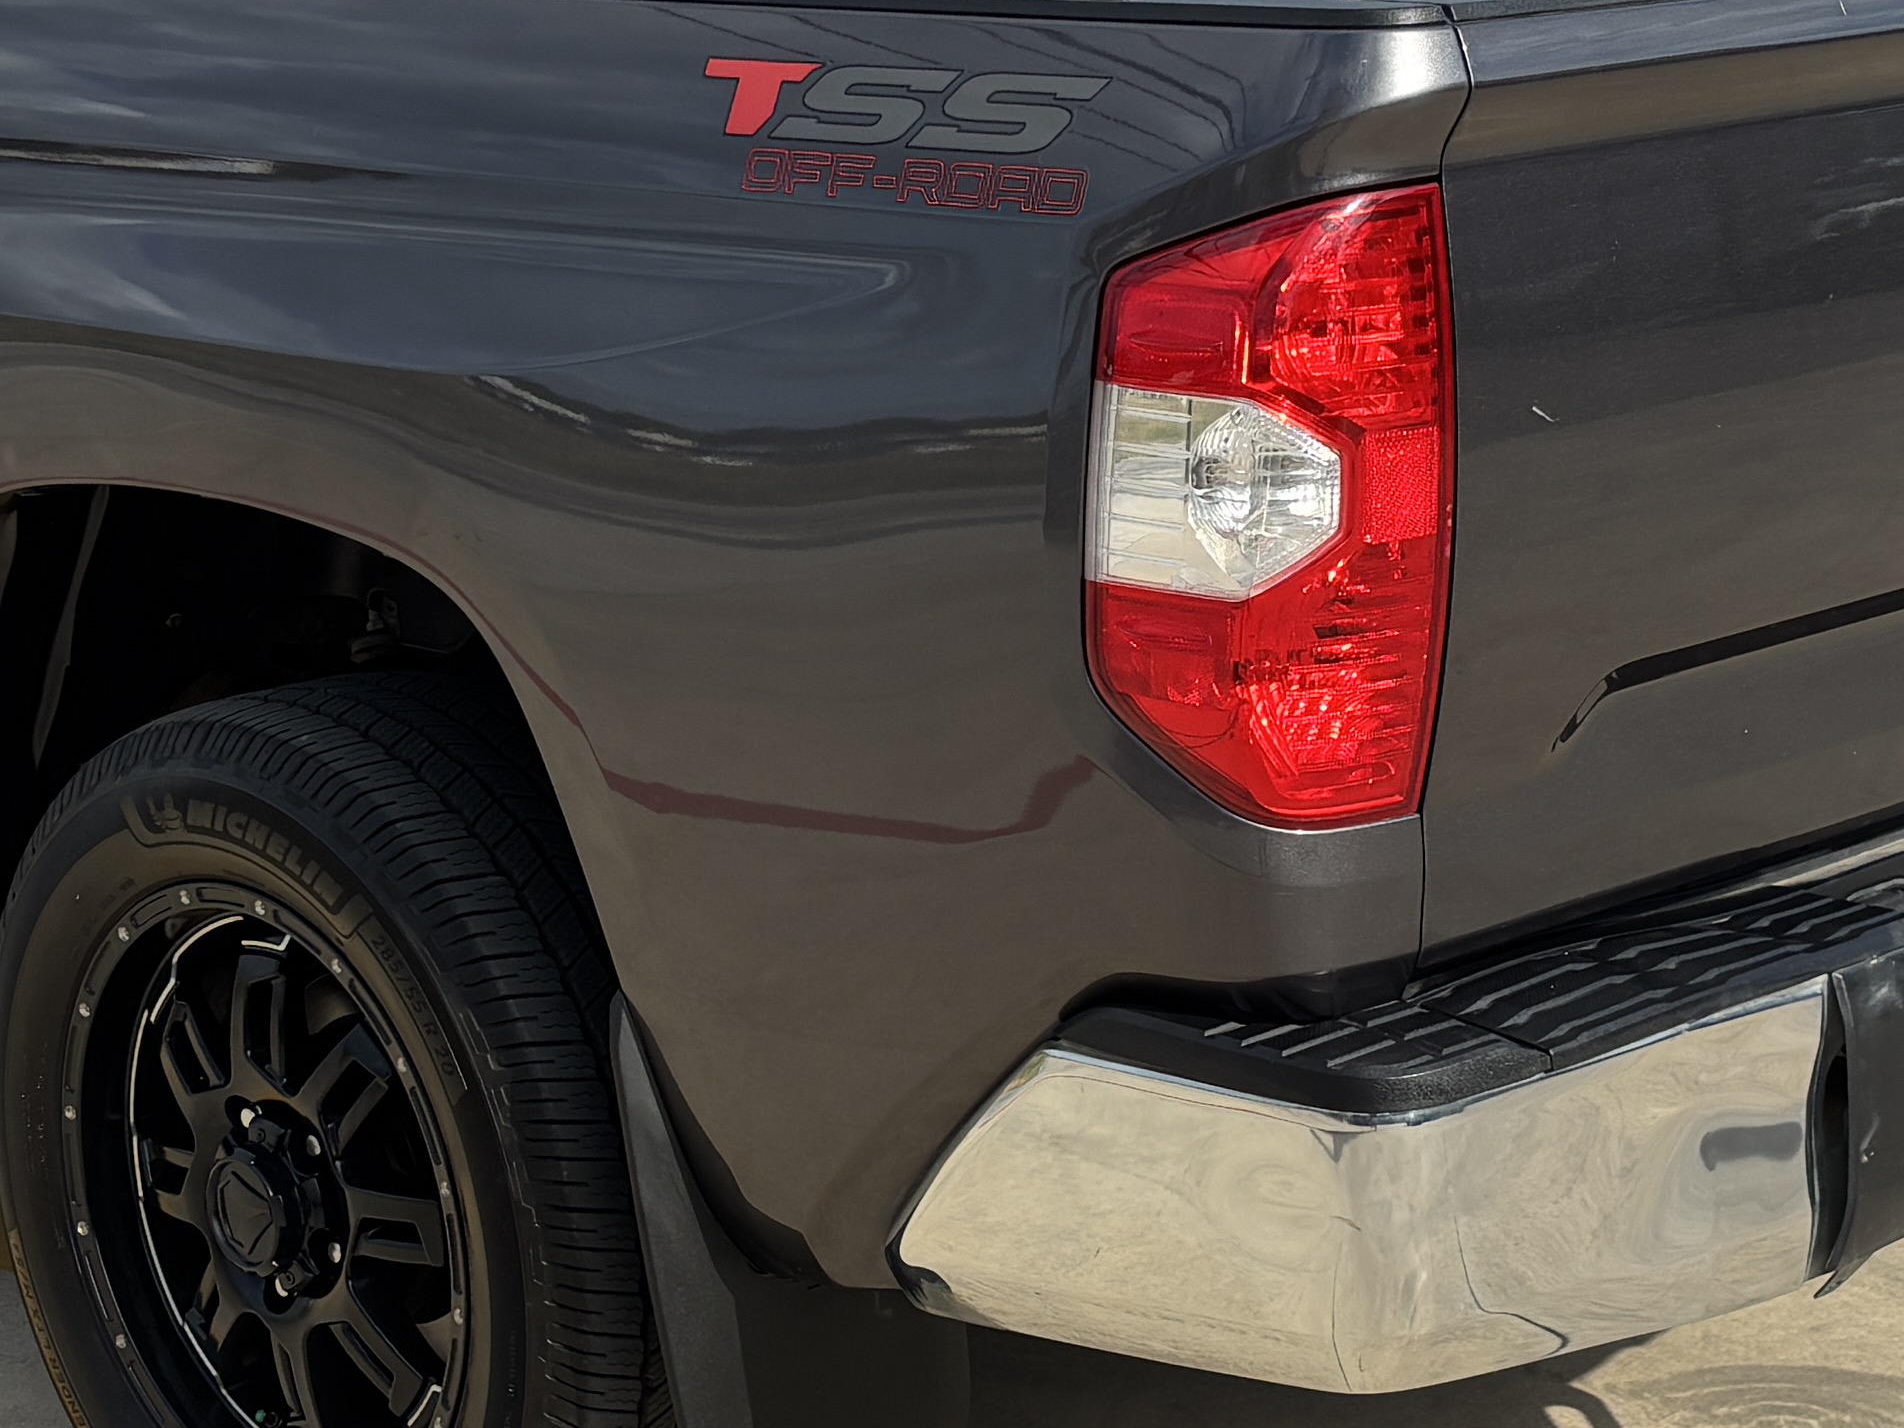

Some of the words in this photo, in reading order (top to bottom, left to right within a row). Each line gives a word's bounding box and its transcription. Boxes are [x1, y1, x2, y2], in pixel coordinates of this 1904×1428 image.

[704, 57, 1113, 155] TSS
[740, 147, 1090, 217] OFF-ROAD
[186, 798, 345, 907] MICHELIN
[371, 936, 423, 1014] 285/55
